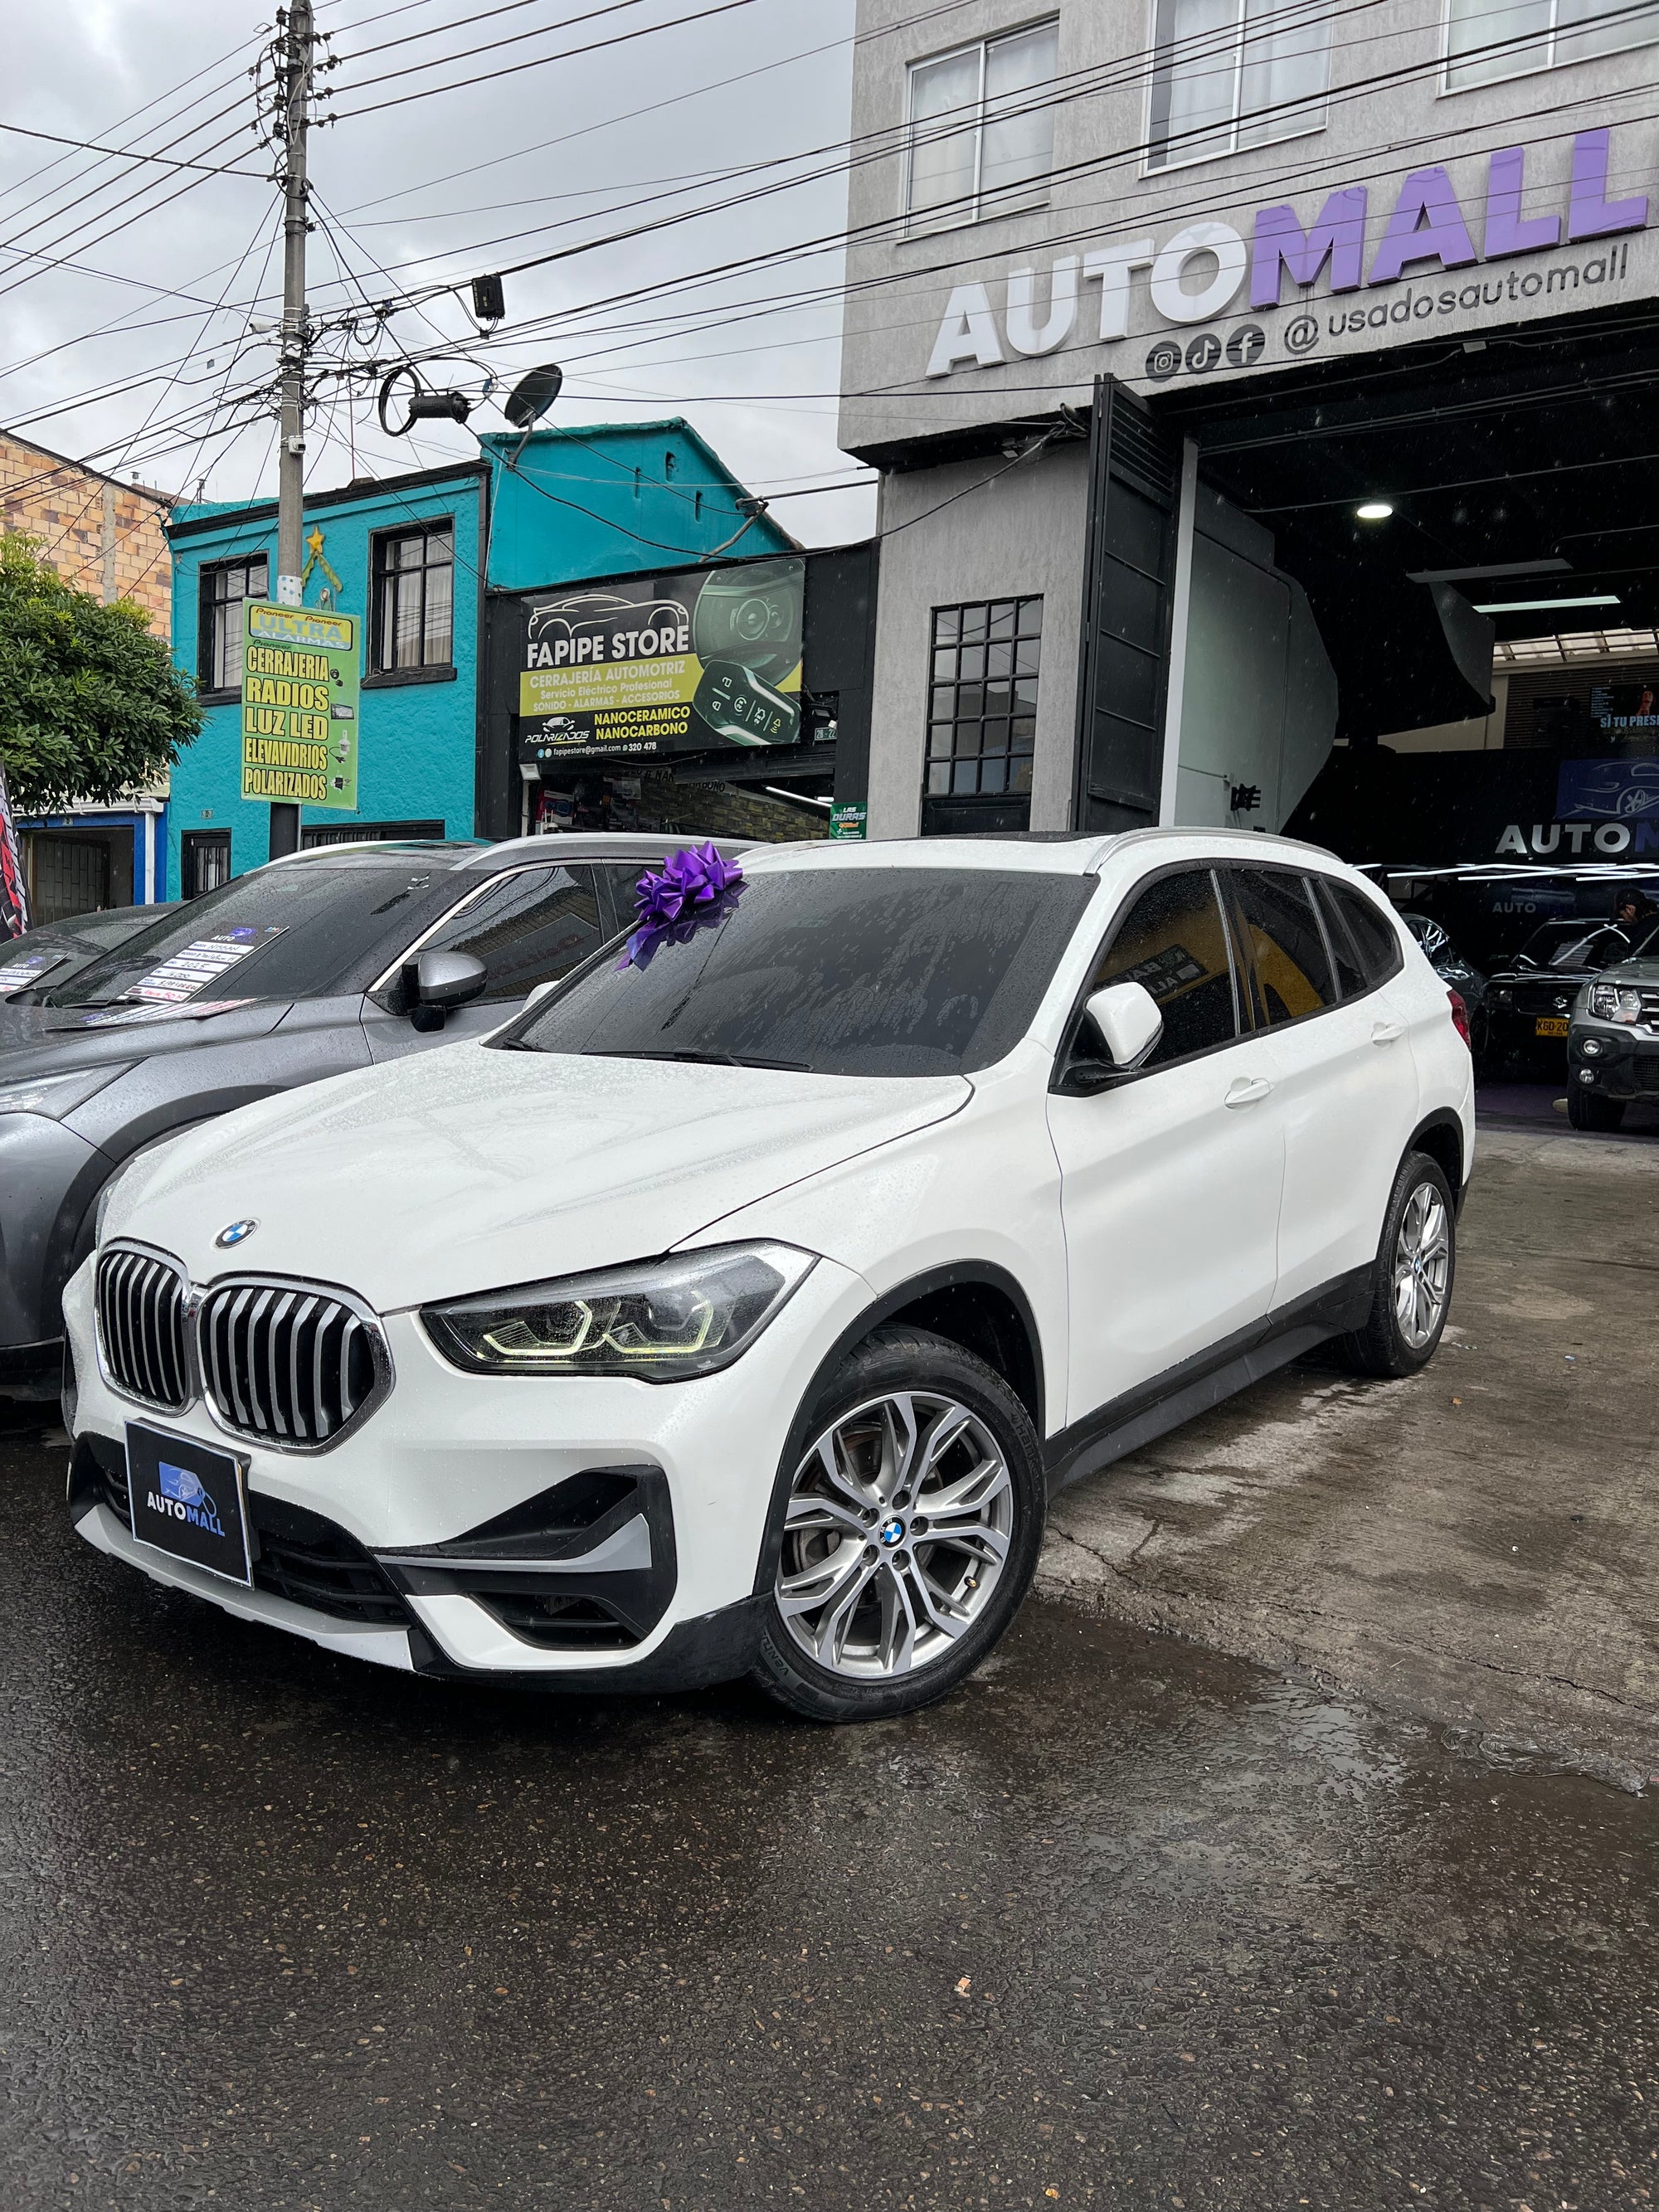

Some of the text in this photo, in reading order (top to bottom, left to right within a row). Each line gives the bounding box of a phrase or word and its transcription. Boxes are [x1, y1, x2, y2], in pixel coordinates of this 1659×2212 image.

[925, 127, 1649, 380] AUTOMALL
[255, 607, 343, 626] Pioneer Pioneer
[260, 615, 343, 639] ULTRA
[253, 639, 291, 649] Pioneer
[257, 631, 345, 648] ALARMAS
[527, 625, 689, 668] FAPIPE STORE
[246, 645, 329, 682] CERRAJERIA
[530, 660, 685, 688] CERRAJERÍA AUTOMOTRIZ
[246, 676, 329, 712] RADIOS
[541, 678, 672, 700] Servicio Eléctrico Profesional
[533, 700, 567, 712] SONIDO
[573, 695, 614, 708] ALARMAS
[621, 690, 680, 704] ACCESORIOS
[246, 707, 328, 741] LUZ LED
[594, 706, 691, 726] NANOCERAMICO
[1613, 716, 1627, 727] TU
[525, 730, 591, 744] POLARIZADOS
[596, 722, 688, 741] NANOCARBONO
[245, 737, 328, 771] ELEVAVIDRIOS
[553, 741, 657, 756] fapipestore@gmail.com 320 478
[244, 767, 328, 800] POLARIZADOS
[832, 812, 867, 822] DURAS
[147, 1490, 226, 1538] AUTOMALL
